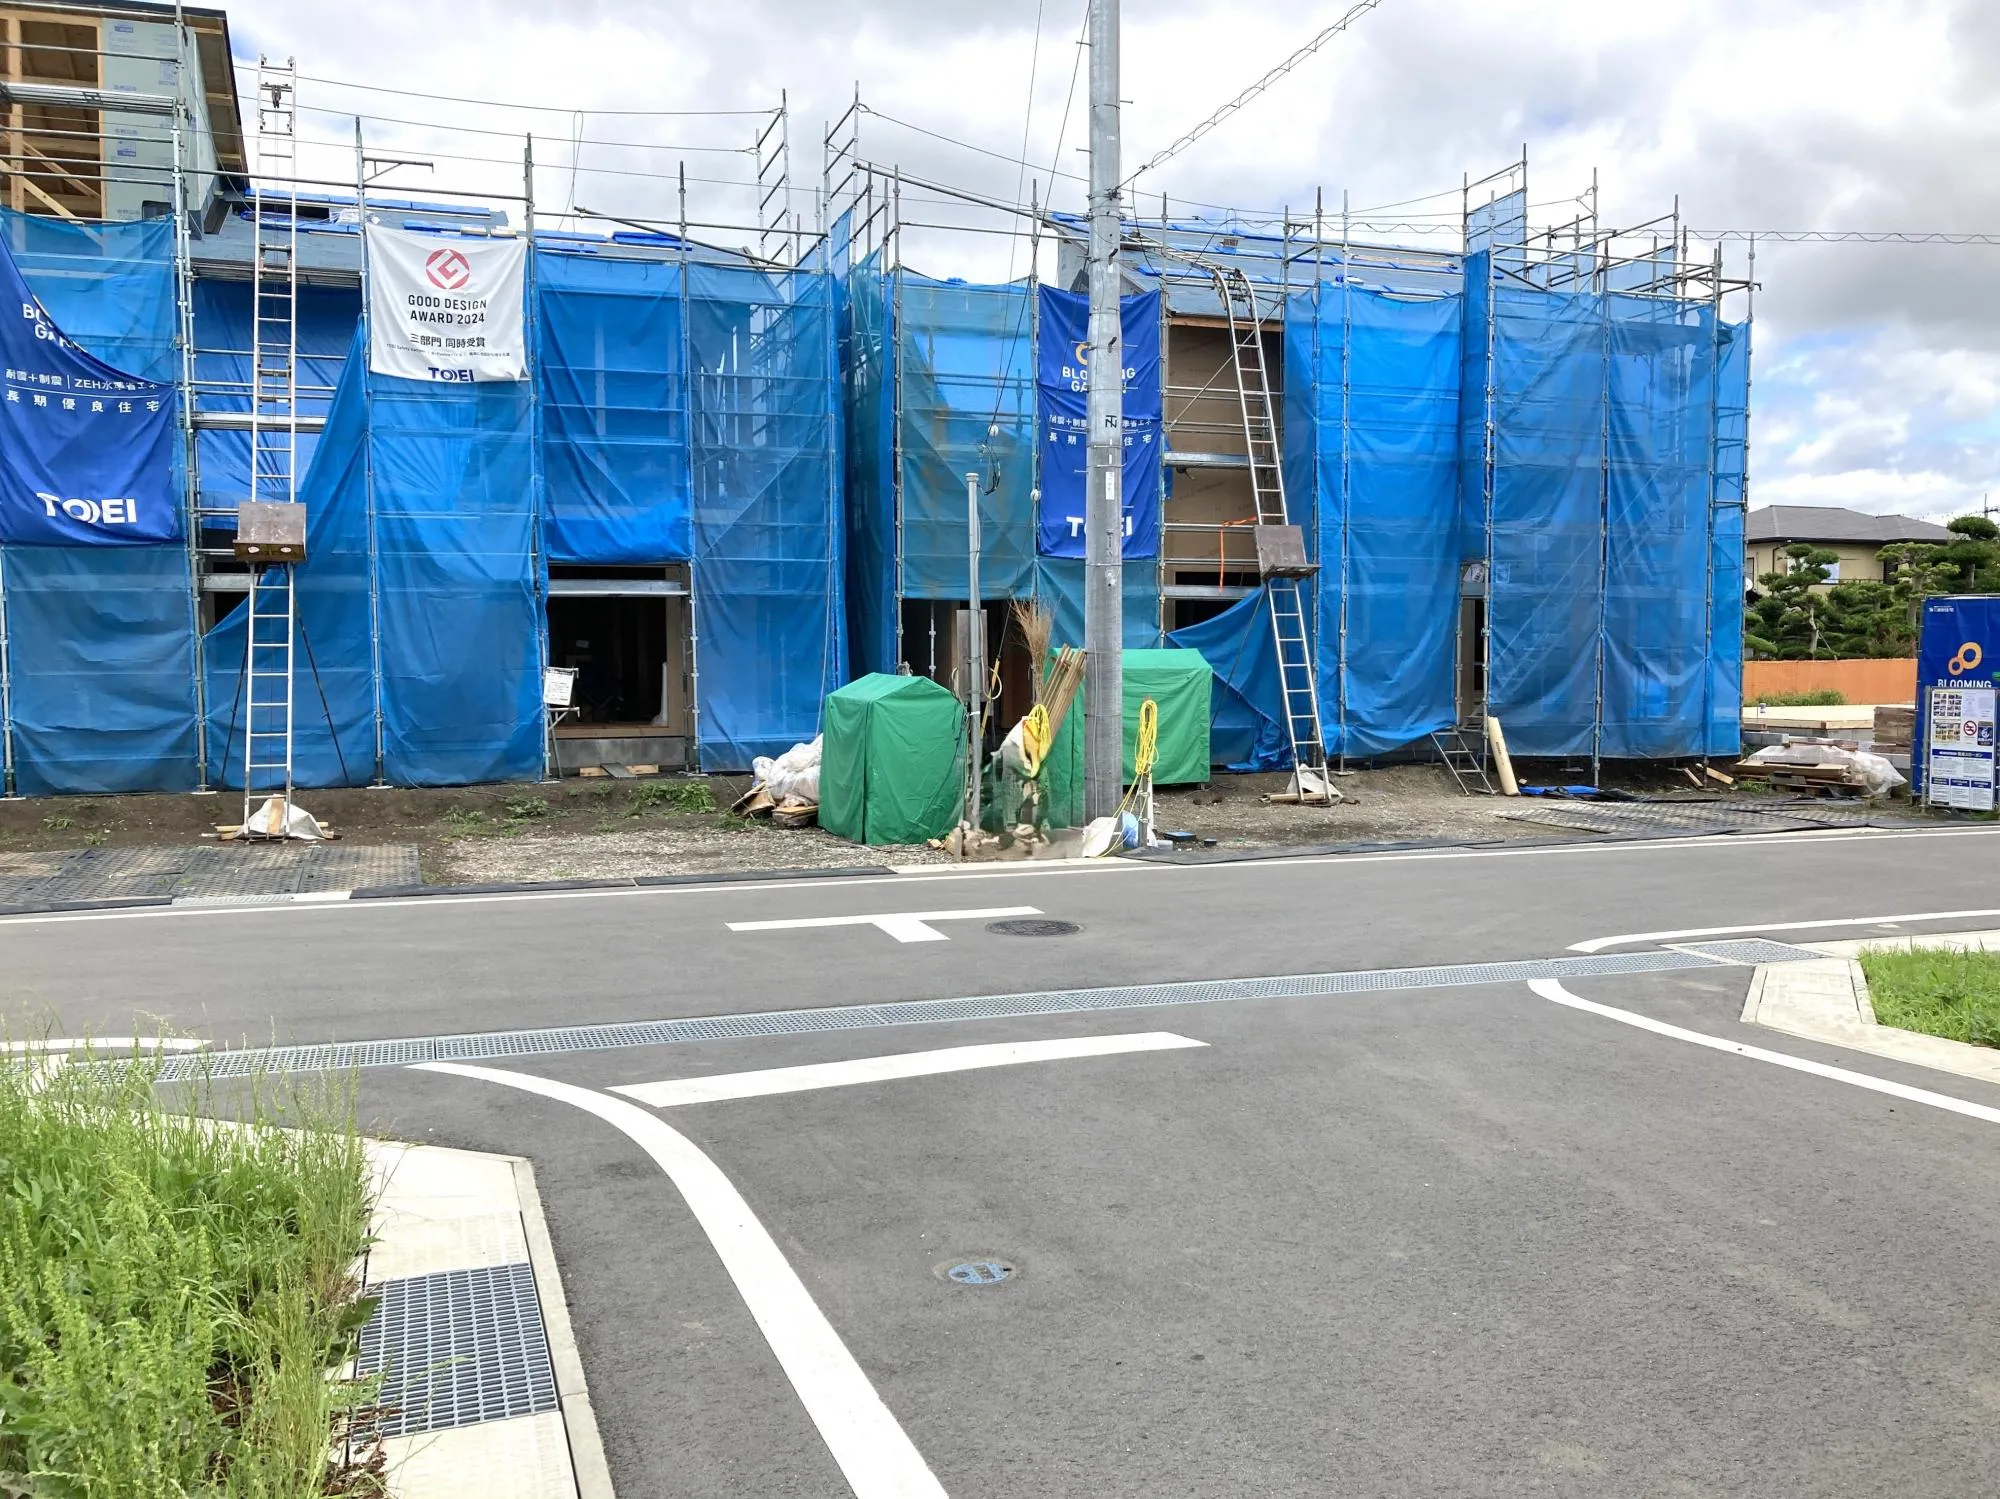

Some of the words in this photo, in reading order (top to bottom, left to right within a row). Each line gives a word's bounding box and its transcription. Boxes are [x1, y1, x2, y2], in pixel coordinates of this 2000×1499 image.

[408, 294, 440, 308] GOOD
[444, 298, 487, 311] DESIGN
[410, 310, 453, 324] AWARD
[457, 313, 485, 325] 2024
[410, 333, 442, 348] 三部門
[445, 336, 486, 349] 同時受賞
[428, 366, 475, 382] TOEI
[6, 390, 160, 413] 長期優良住宅
[36, 492, 137, 524] TOEI
